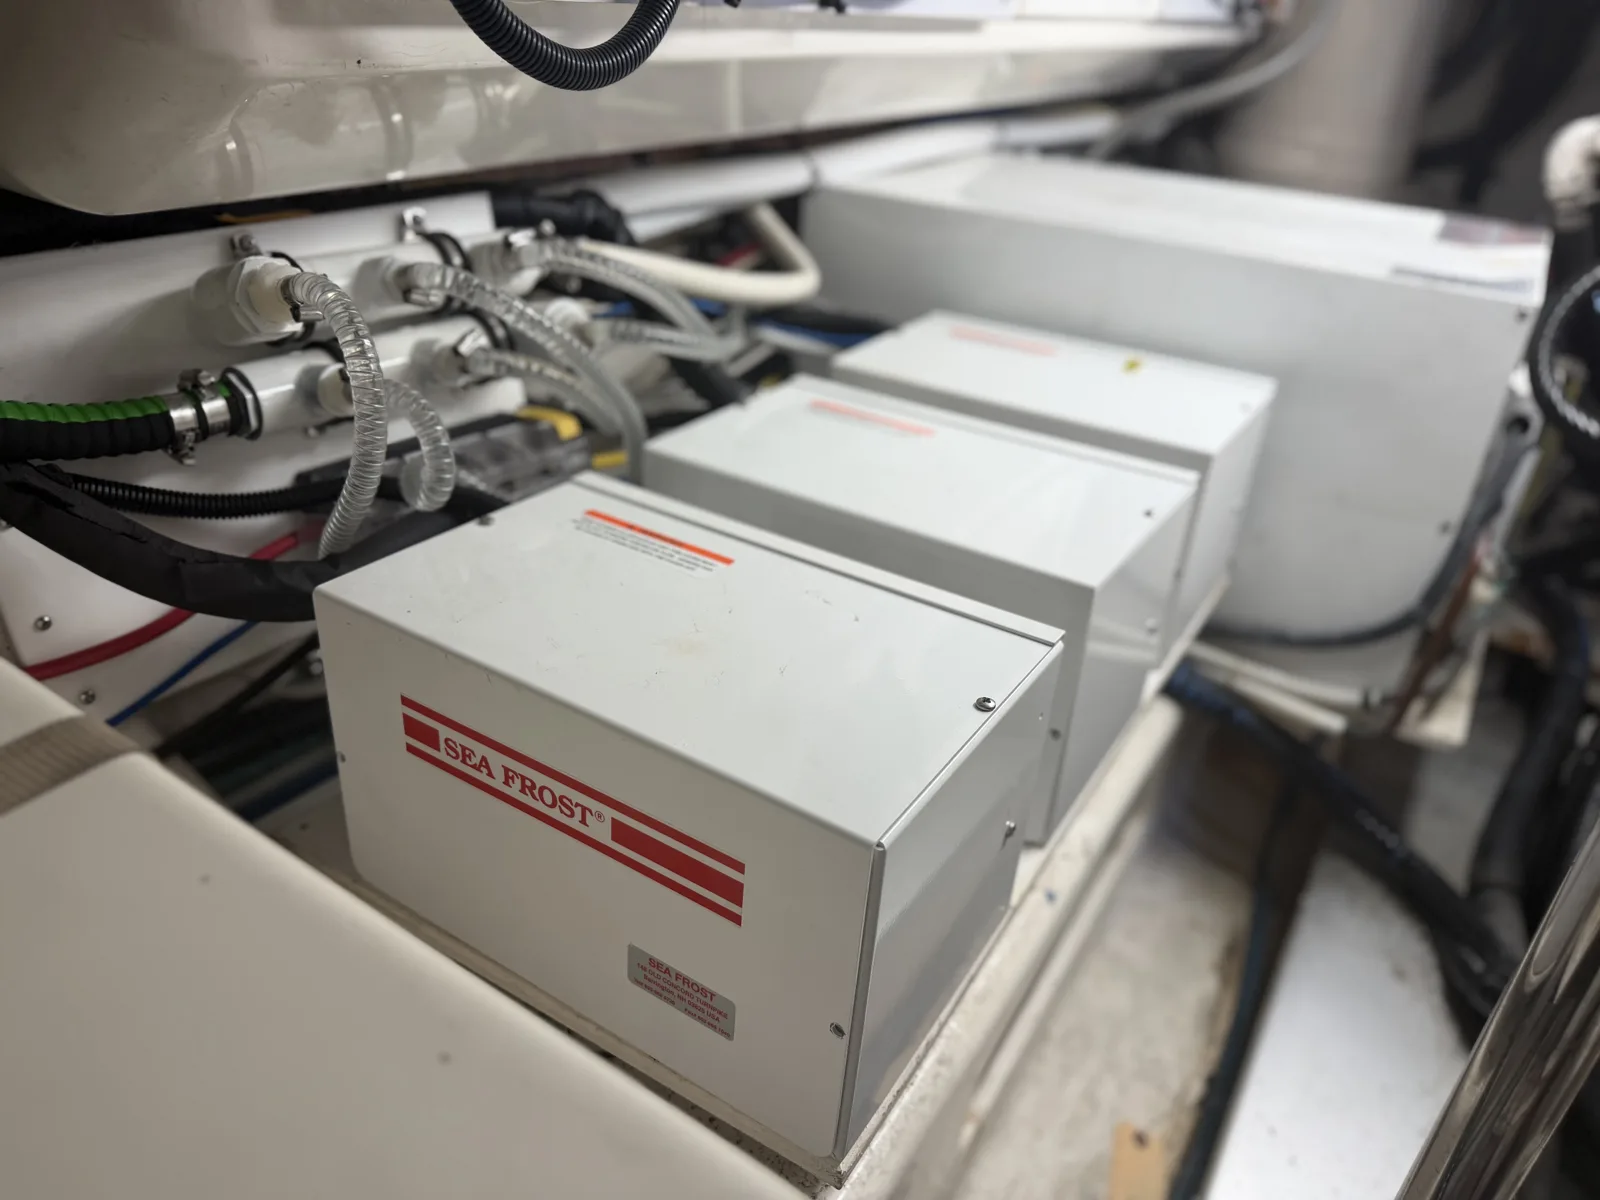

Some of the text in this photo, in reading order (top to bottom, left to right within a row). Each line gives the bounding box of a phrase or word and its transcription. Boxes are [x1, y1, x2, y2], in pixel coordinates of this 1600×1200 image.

[444, 737, 496, 780] SEA
[648, 957, 671, 978] SEA
[675, 972, 717, 1002] FROST
[648, 968, 662, 980] OLD
[662, 976, 695, 1000] CONCORD
[706, 1010, 720, 1022] USA
